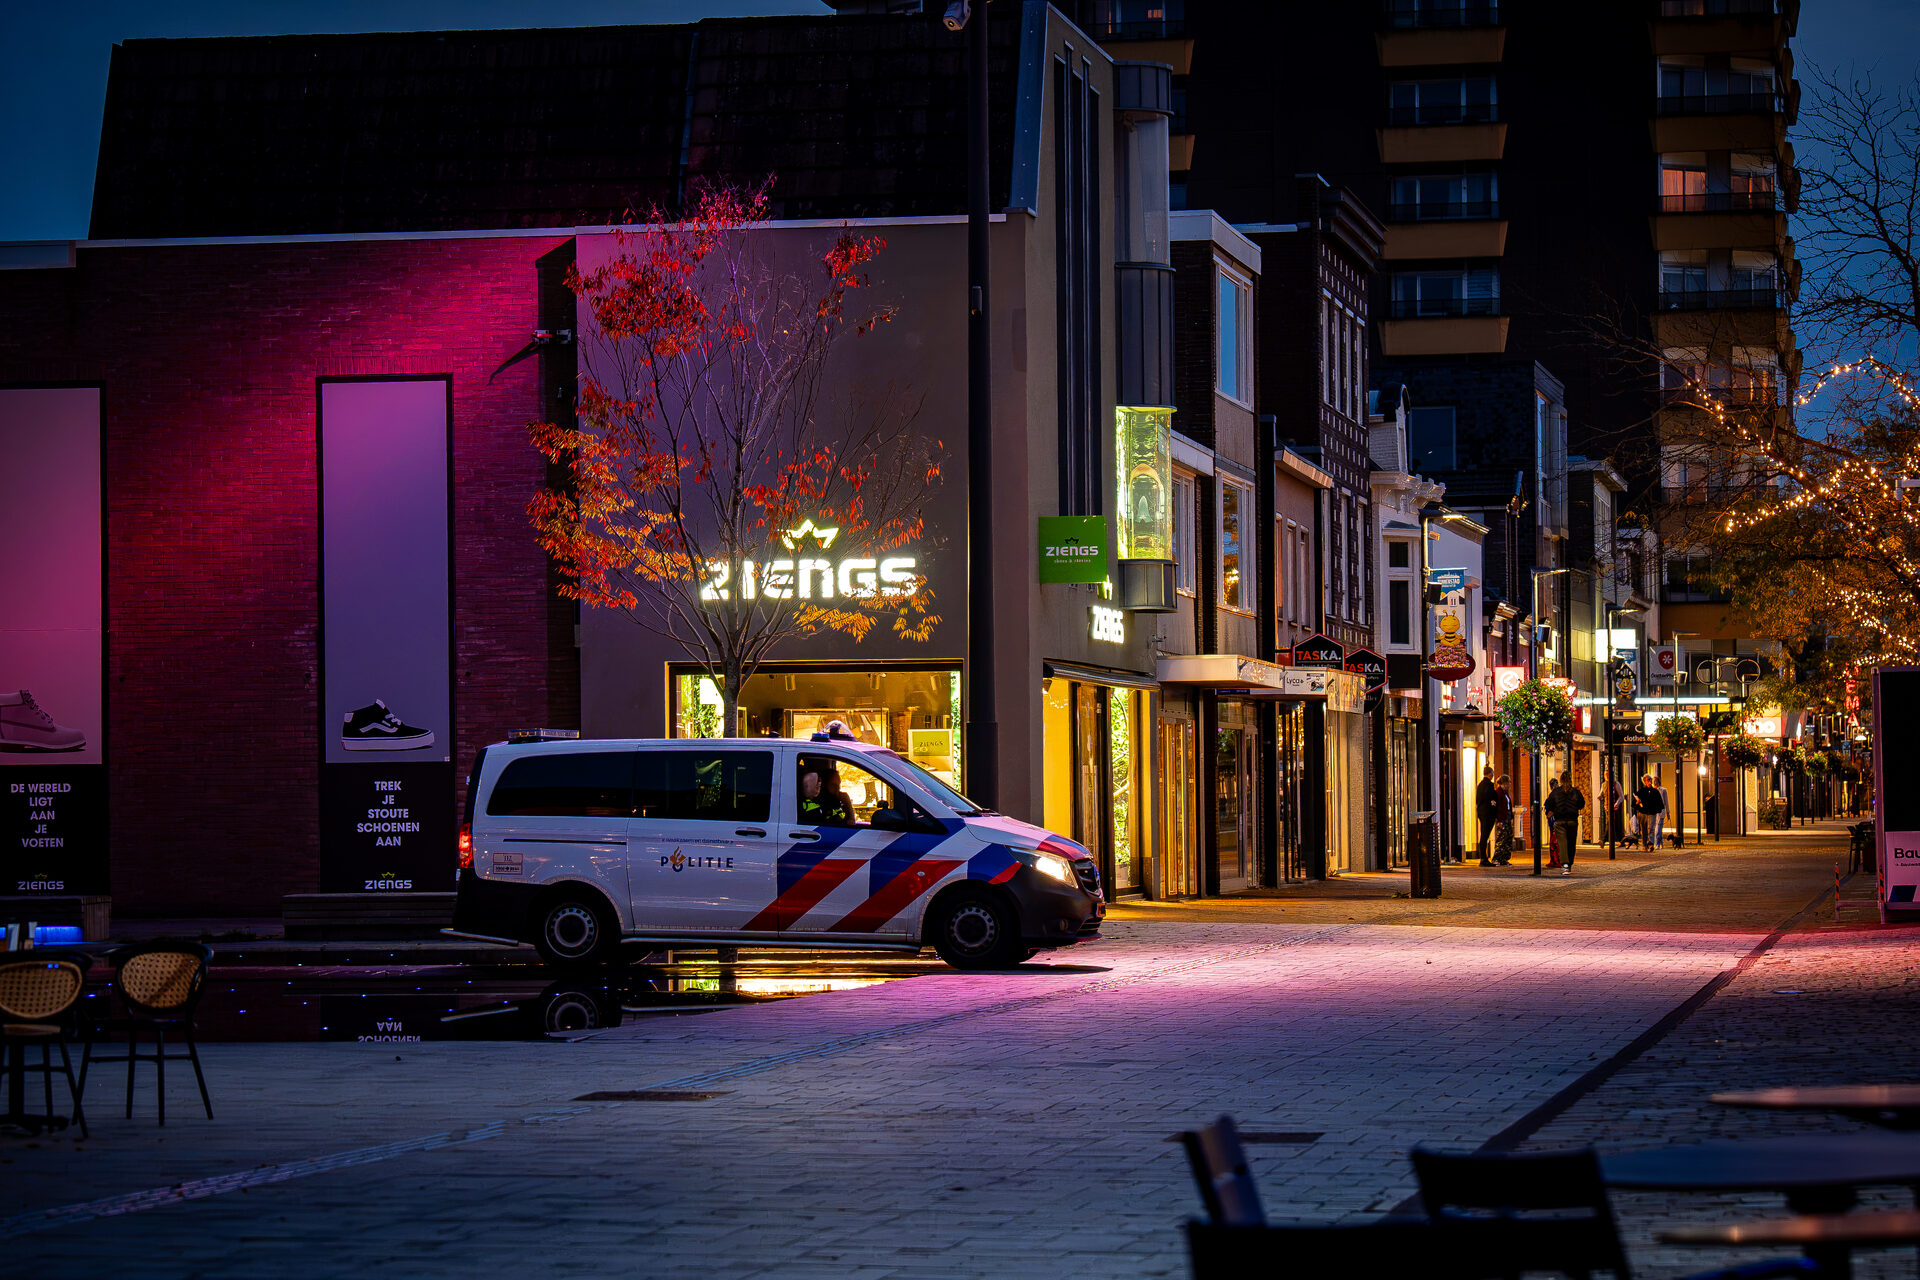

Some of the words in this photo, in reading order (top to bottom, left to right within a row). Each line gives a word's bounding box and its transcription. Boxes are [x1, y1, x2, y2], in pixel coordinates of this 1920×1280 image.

[1296, 650, 1342, 661] TASKA.
[10, 783, 25, 793] DE
[28, 783, 72, 793] WERELD
[374, 780, 402, 791] TREK
[28, 796, 54, 807] LIGT
[381, 794, 395, 805] JE
[30, 810, 56, 820] AAN
[367, 808, 409, 819] STOUTE
[34, 824, 48, 834] JE
[356, 822, 420, 833] SCHOENEN
[21, 837, 64, 848] VOETEN
[375, 836, 402, 847] AAN
[661, 856, 733, 872] POLITIE
